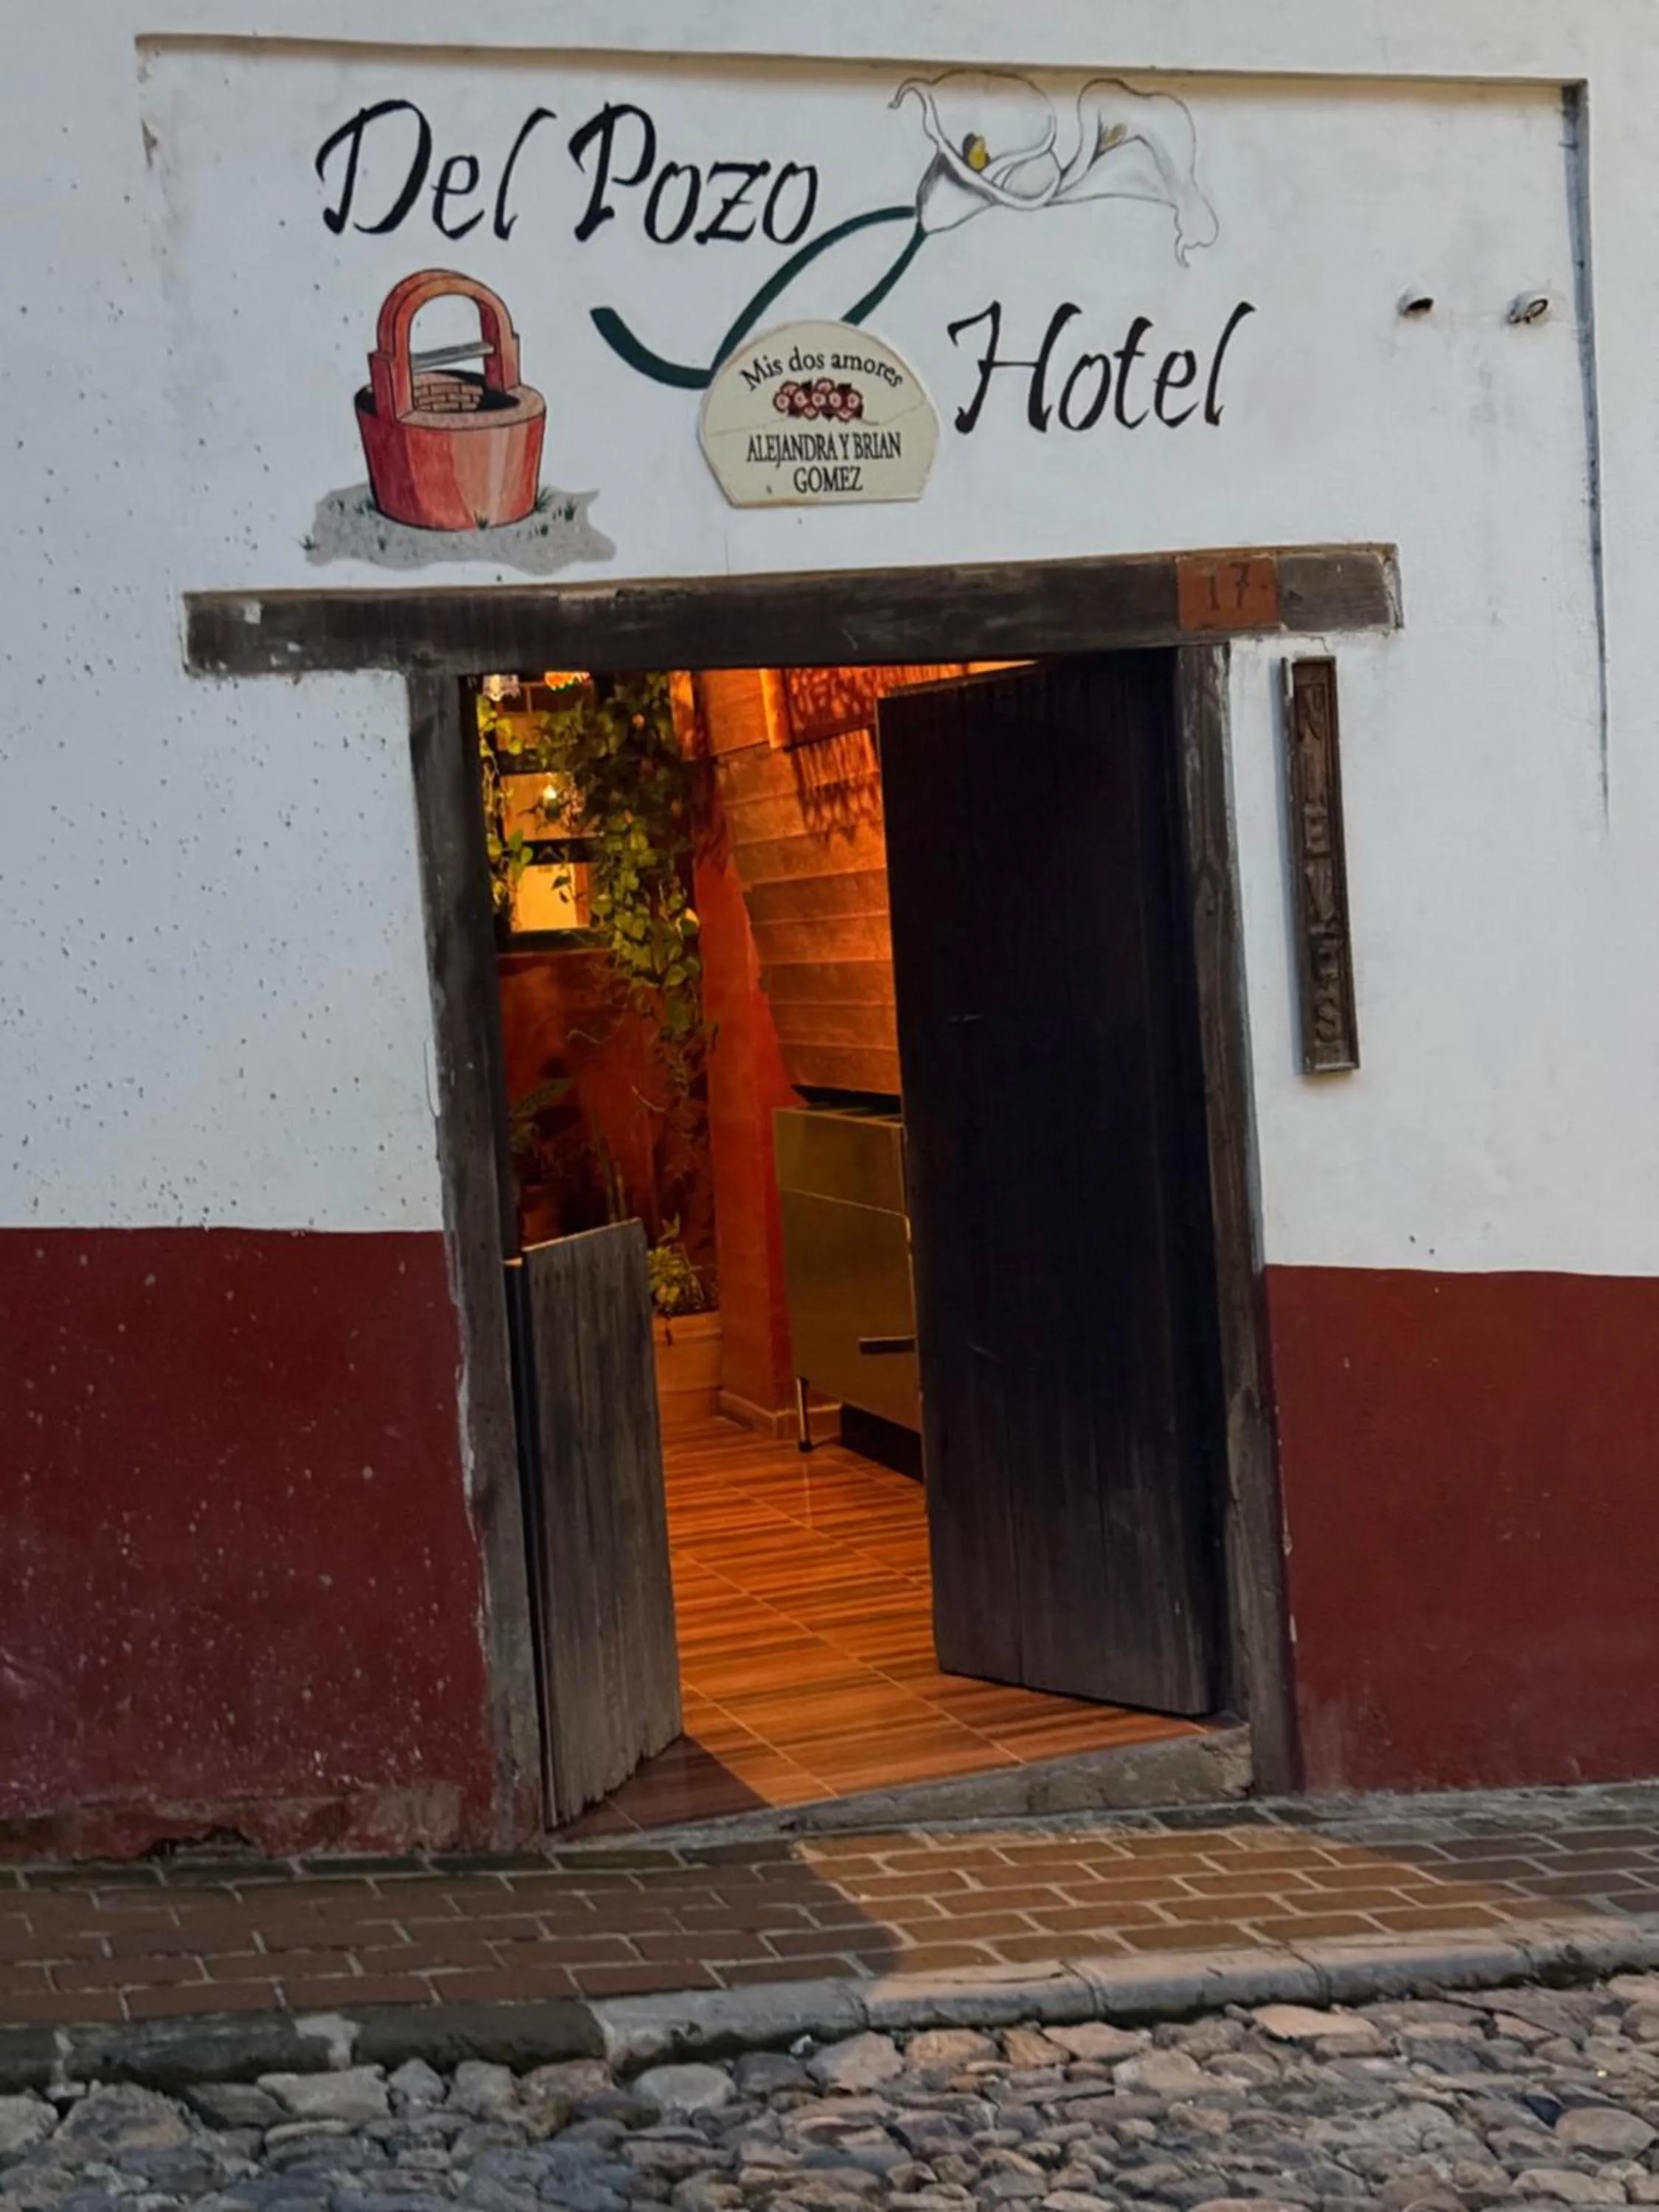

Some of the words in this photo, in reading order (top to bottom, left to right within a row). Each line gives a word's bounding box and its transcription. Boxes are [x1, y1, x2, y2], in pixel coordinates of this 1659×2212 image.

[315, 100, 557, 240] Del
[568, 102, 818, 245] Pozo
[740, 355, 783, 392] Mis
[788, 346, 824, 372] dos
[831, 352, 903, 388] amores
[947, 301, 1256, 434] Hotel
[746, 433, 838, 469] ALEJANDRA
[838, 433, 850, 461] Y
[854, 431, 902, 460] BRIAN
[793, 465, 863, 494] GOMEZ
